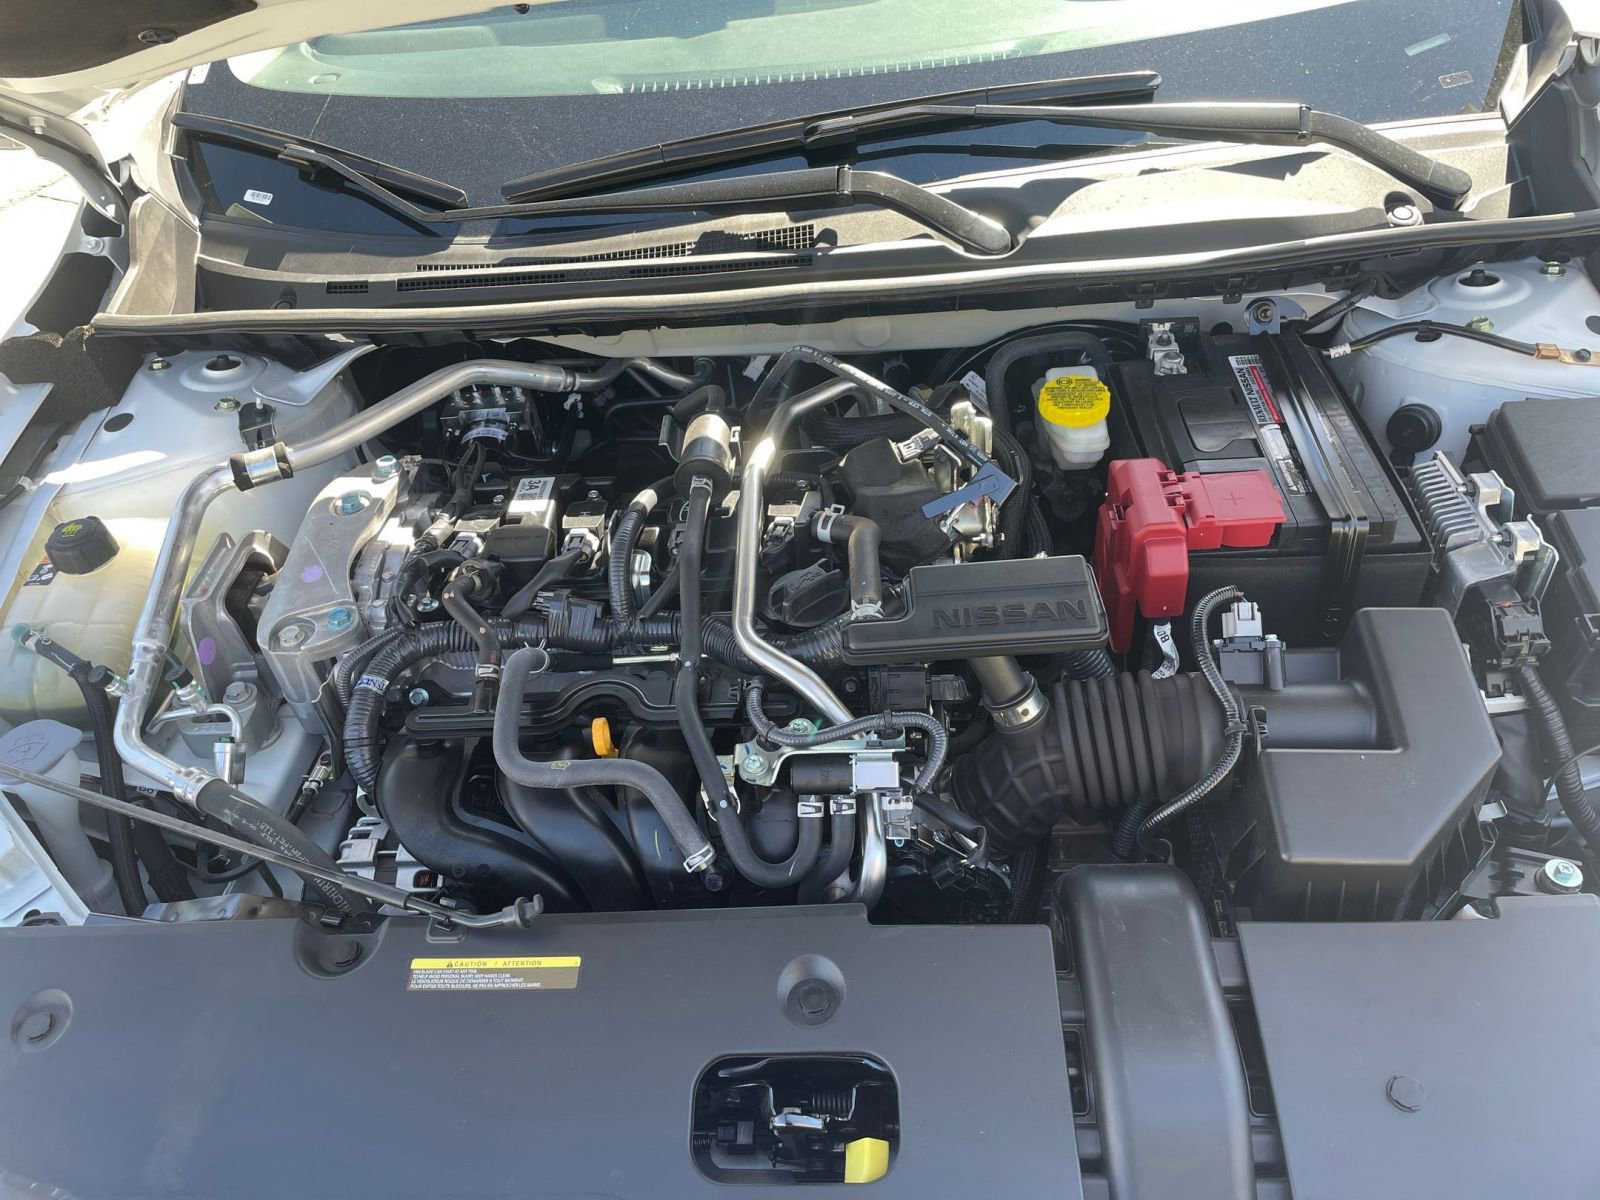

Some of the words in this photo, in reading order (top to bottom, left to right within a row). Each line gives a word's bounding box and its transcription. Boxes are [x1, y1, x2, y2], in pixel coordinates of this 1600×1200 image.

[1236, 367, 1256, 396] NISSAN
[1249, 396, 1268, 423] RENAULT
[932, 600, 1087, 629] NISSAN
